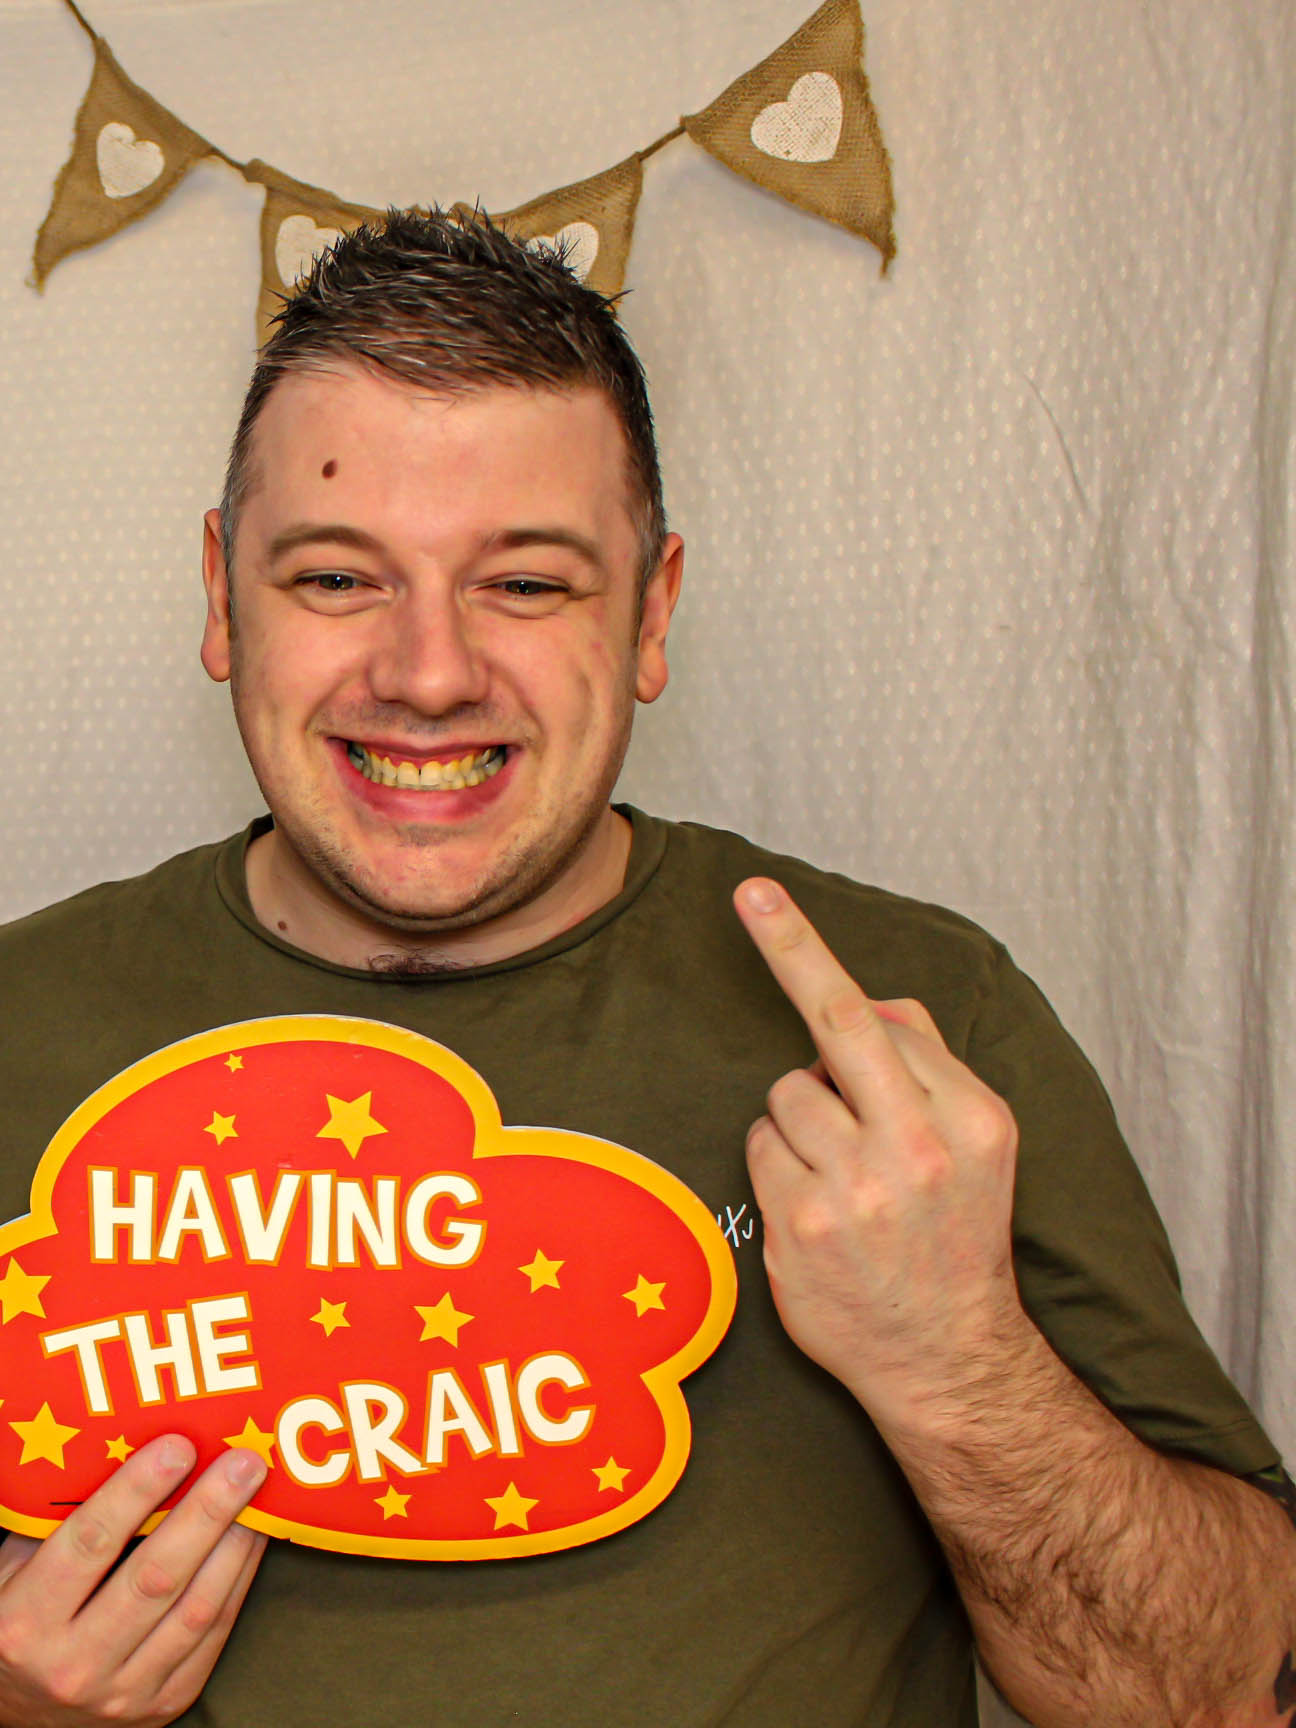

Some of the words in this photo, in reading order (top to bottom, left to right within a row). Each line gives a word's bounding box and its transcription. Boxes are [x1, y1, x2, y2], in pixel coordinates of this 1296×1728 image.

[90, 1168, 484, 1267] HAVING
[42, 1294, 259, 1413] THE
[277, 1354, 593, 1485] CRAIC
